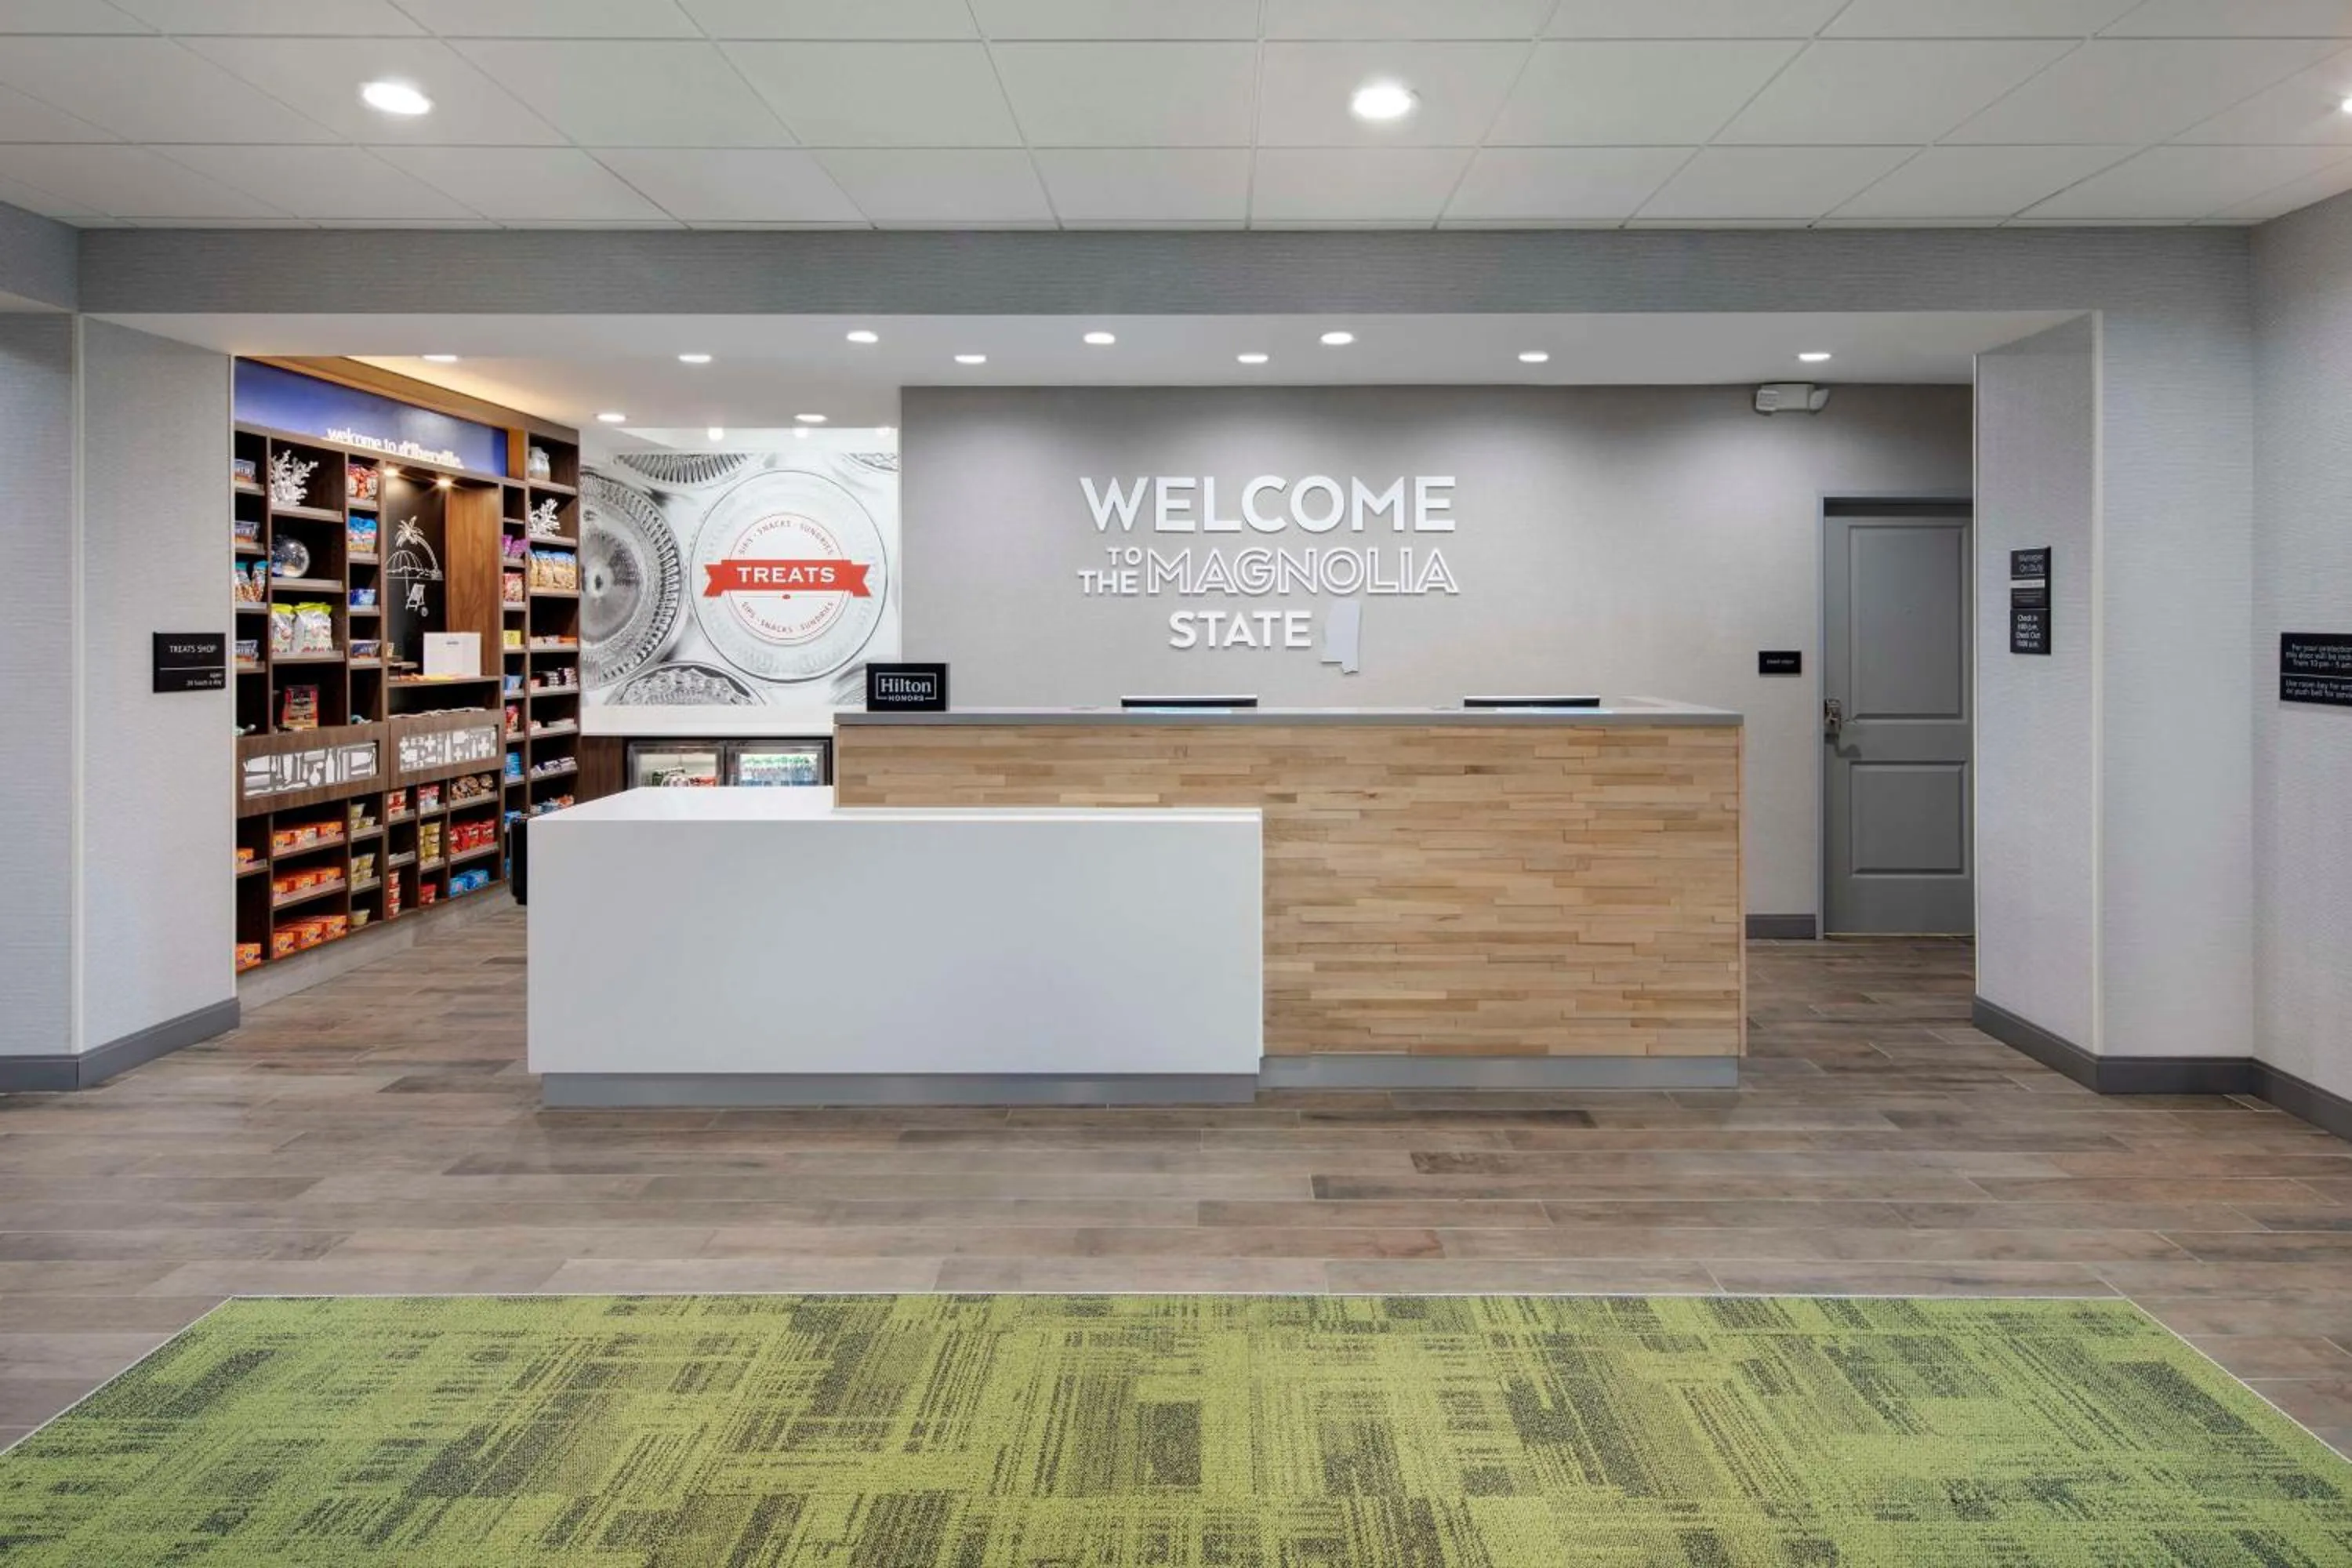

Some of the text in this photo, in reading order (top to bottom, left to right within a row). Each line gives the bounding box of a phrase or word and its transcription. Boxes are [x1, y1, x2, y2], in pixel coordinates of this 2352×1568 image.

[326, 426, 382, 450] welcome
[384, 437, 397, 453] to
[1079, 475, 1456, 532] WELCOME
[757, 520, 792, 535] SNACKS
[736, 566, 836, 583] TREATS
[1108, 547, 1459, 594] TO MAGNOLIA
[1078, 571, 1138, 593] THE
[760, 619, 793, 633] SNACKS
[1169, 611, 1312, 648] STATE
[880, 678, 931, 693] Hilton
